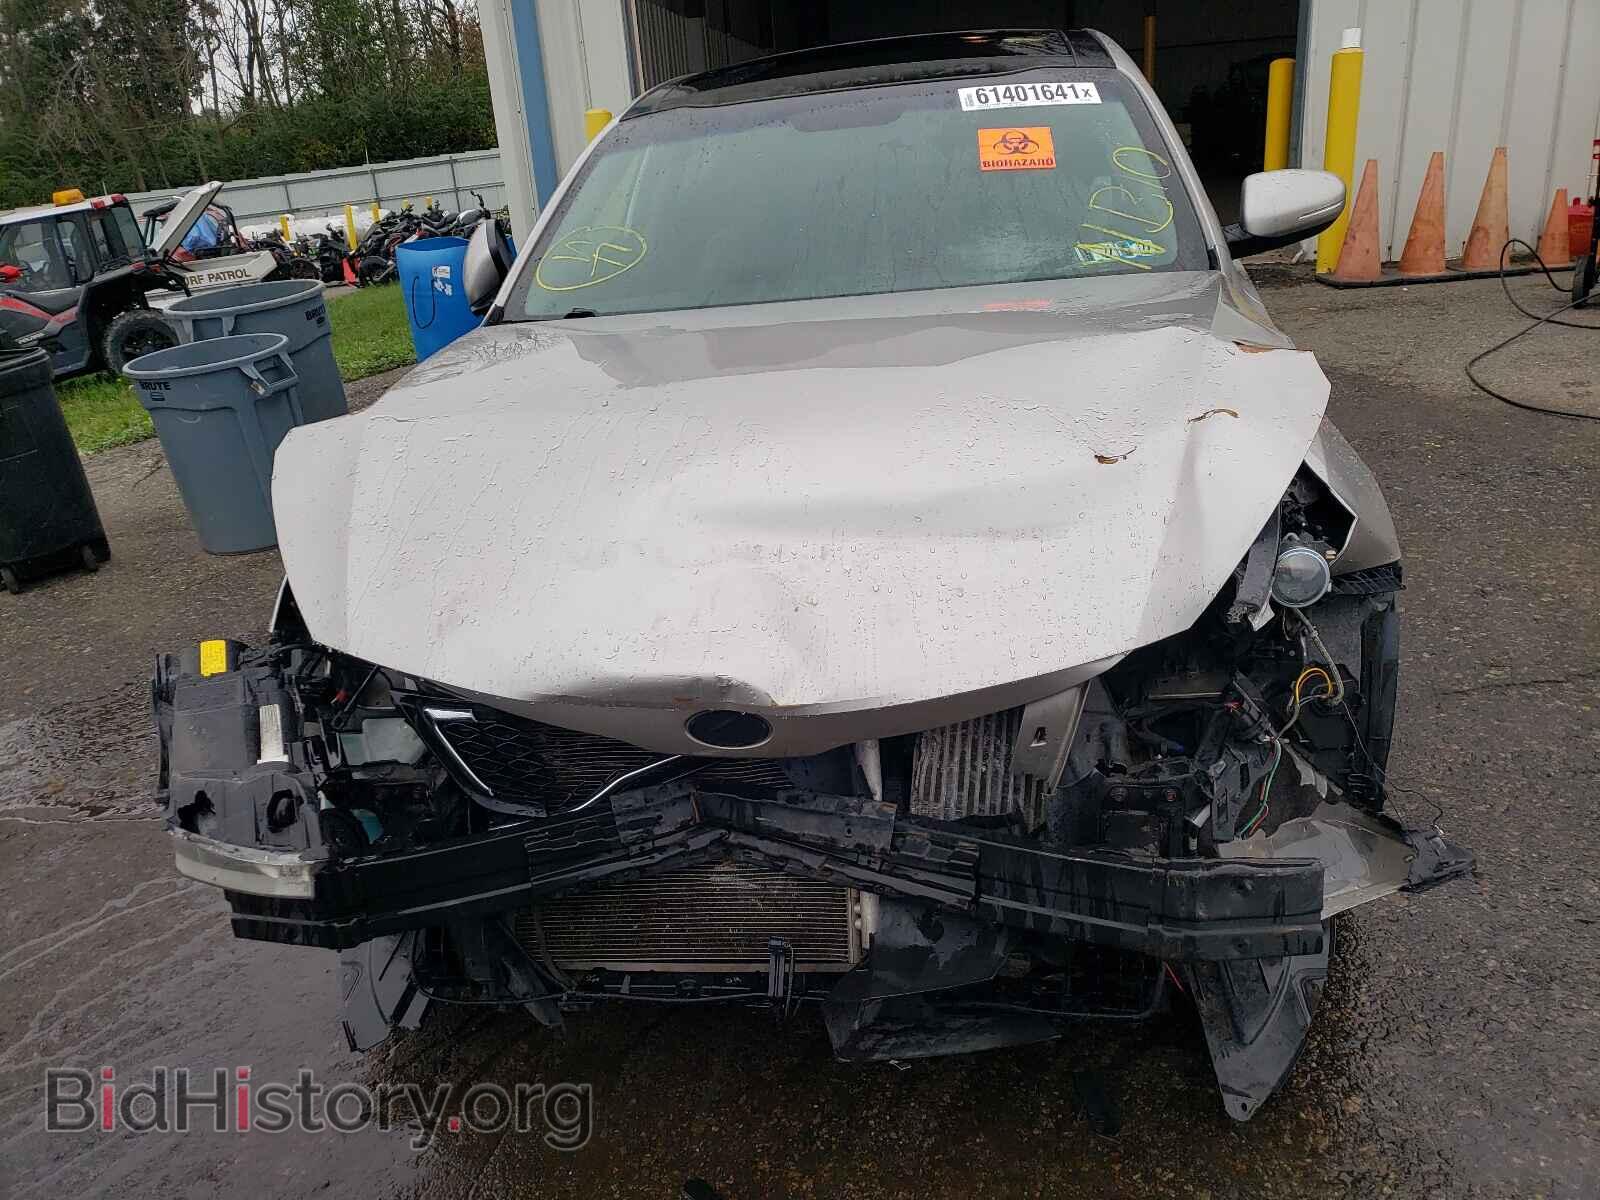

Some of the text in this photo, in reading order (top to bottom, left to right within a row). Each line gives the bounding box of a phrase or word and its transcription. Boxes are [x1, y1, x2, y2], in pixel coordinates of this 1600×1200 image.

[982, 157, 1055, 169] BIOHAZARD
[207, 268, 252, 283] PATROL
[138, 380, 172, 391] BRUTE
